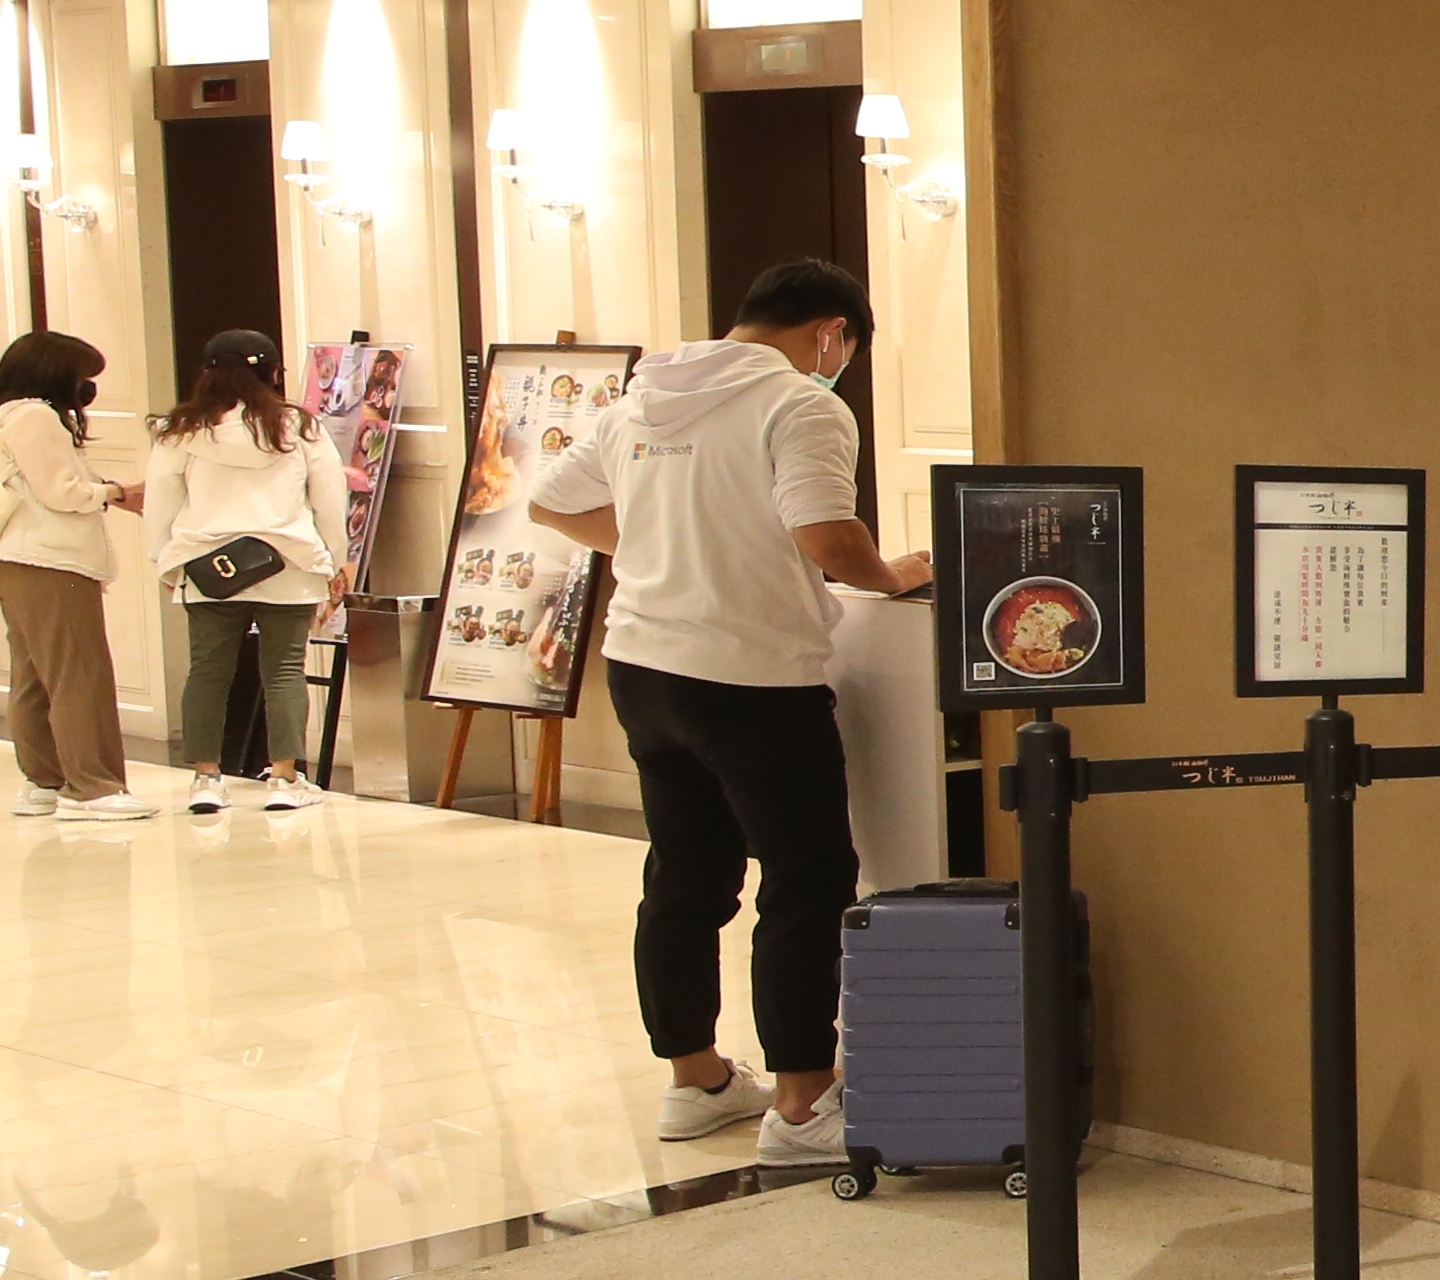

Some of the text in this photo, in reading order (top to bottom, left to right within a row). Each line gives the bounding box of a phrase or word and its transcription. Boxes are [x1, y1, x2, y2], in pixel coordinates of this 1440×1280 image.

[1308, 499, 1357, 516] つじ半
[1181, 765, 1237, 784] つじ半
